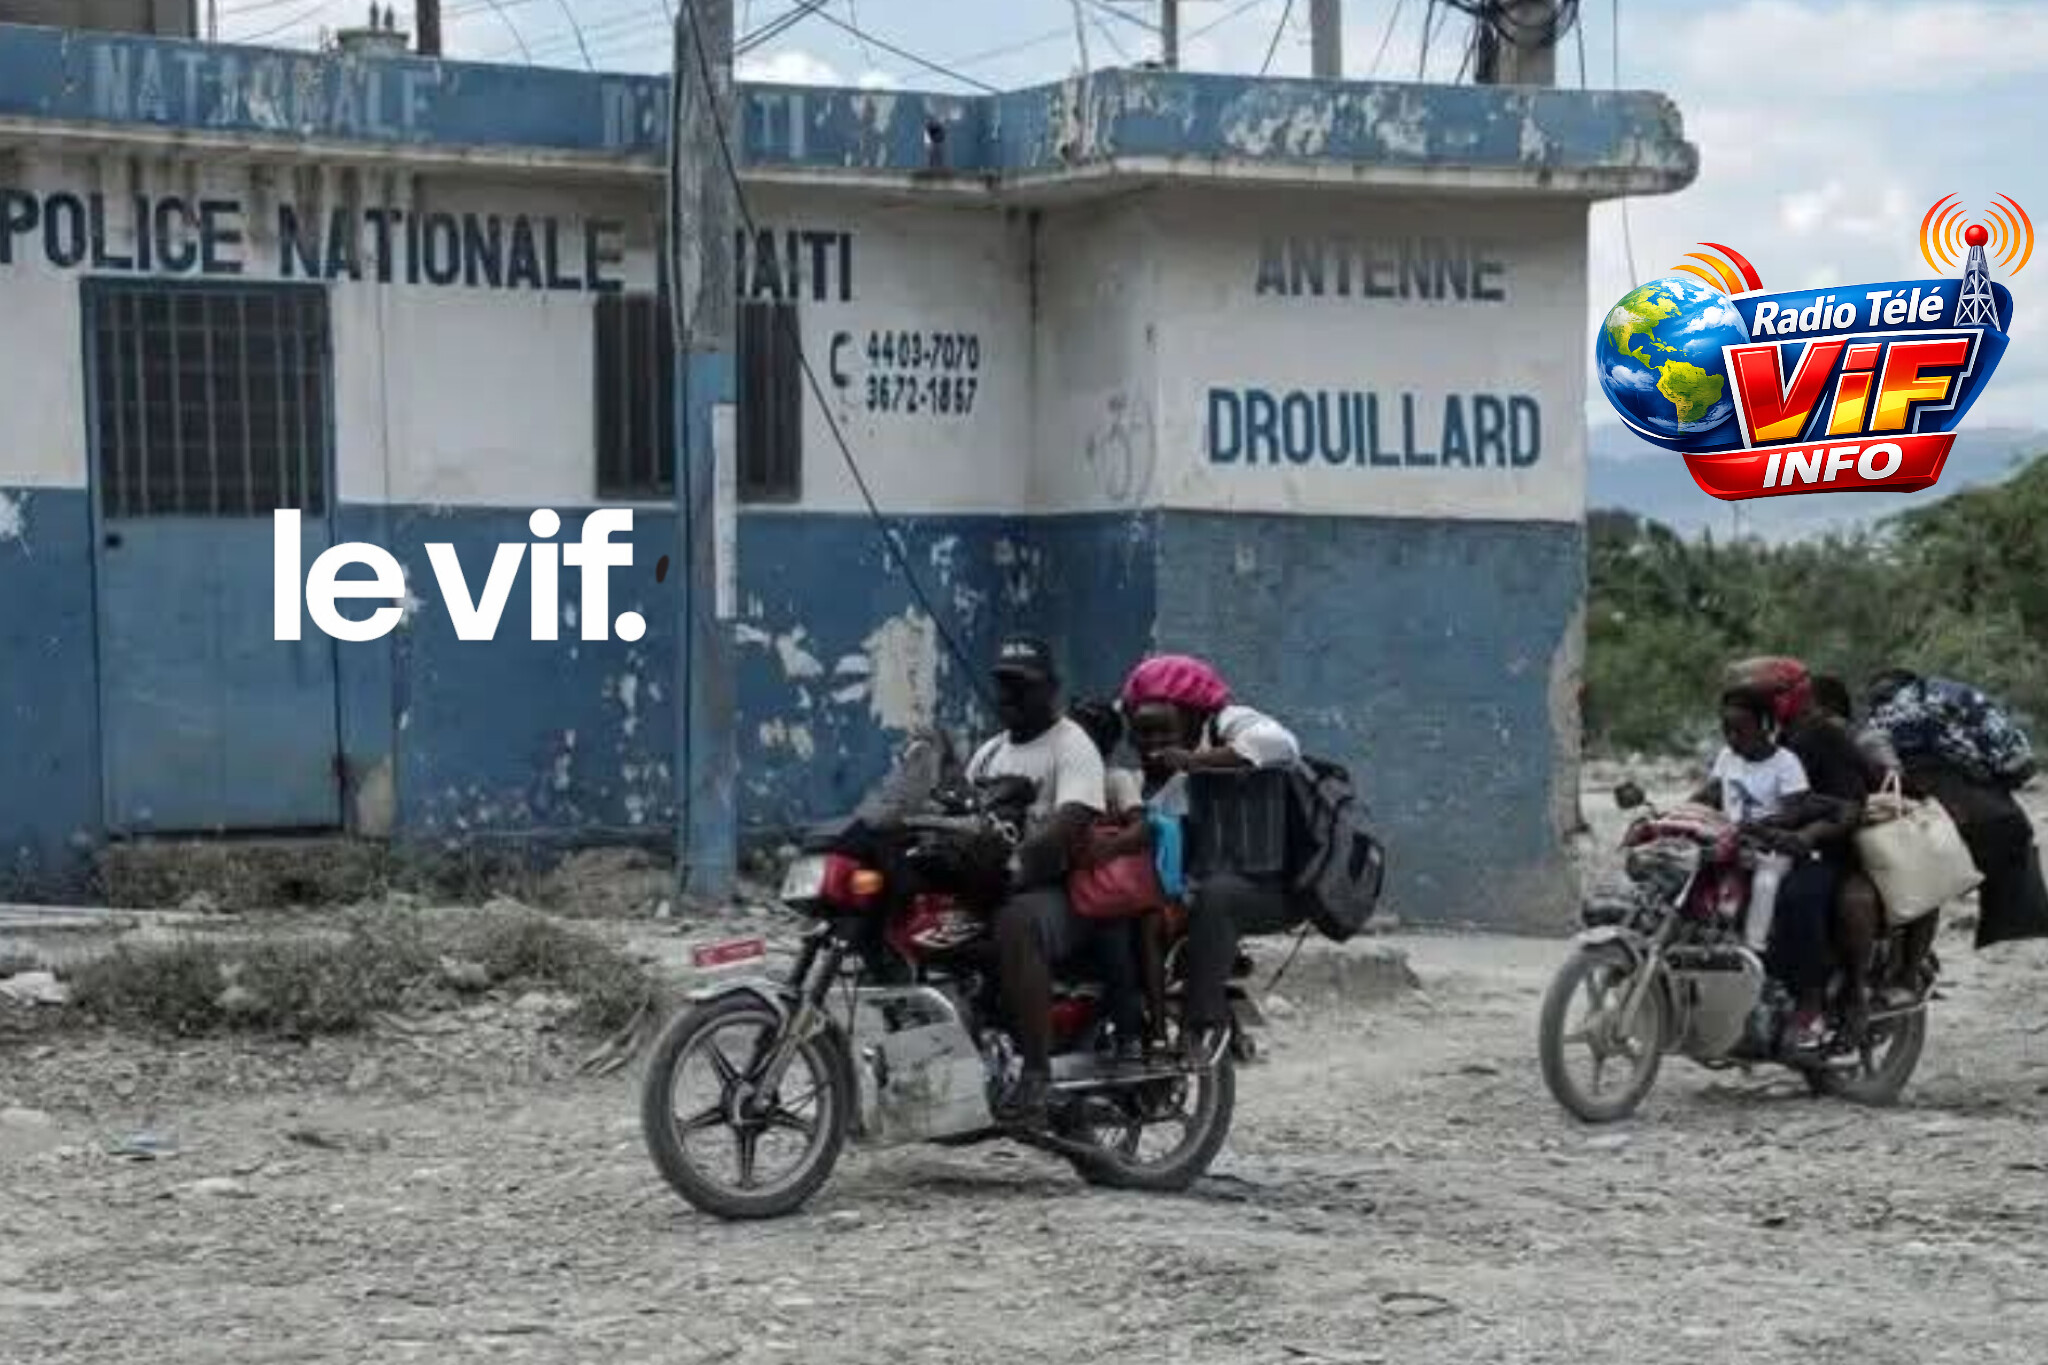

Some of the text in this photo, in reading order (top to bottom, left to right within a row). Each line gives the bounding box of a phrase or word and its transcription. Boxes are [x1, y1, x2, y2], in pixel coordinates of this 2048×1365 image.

[0, 188, 243, 274] POLICE
[278, 202, 624, 292] NATIONALE
[1254, 236, 1506, 302] ANTENNE
[867, 331, 979, 370] 4403-7070
[1208, 388, 1542, 468] DROUILLARD
